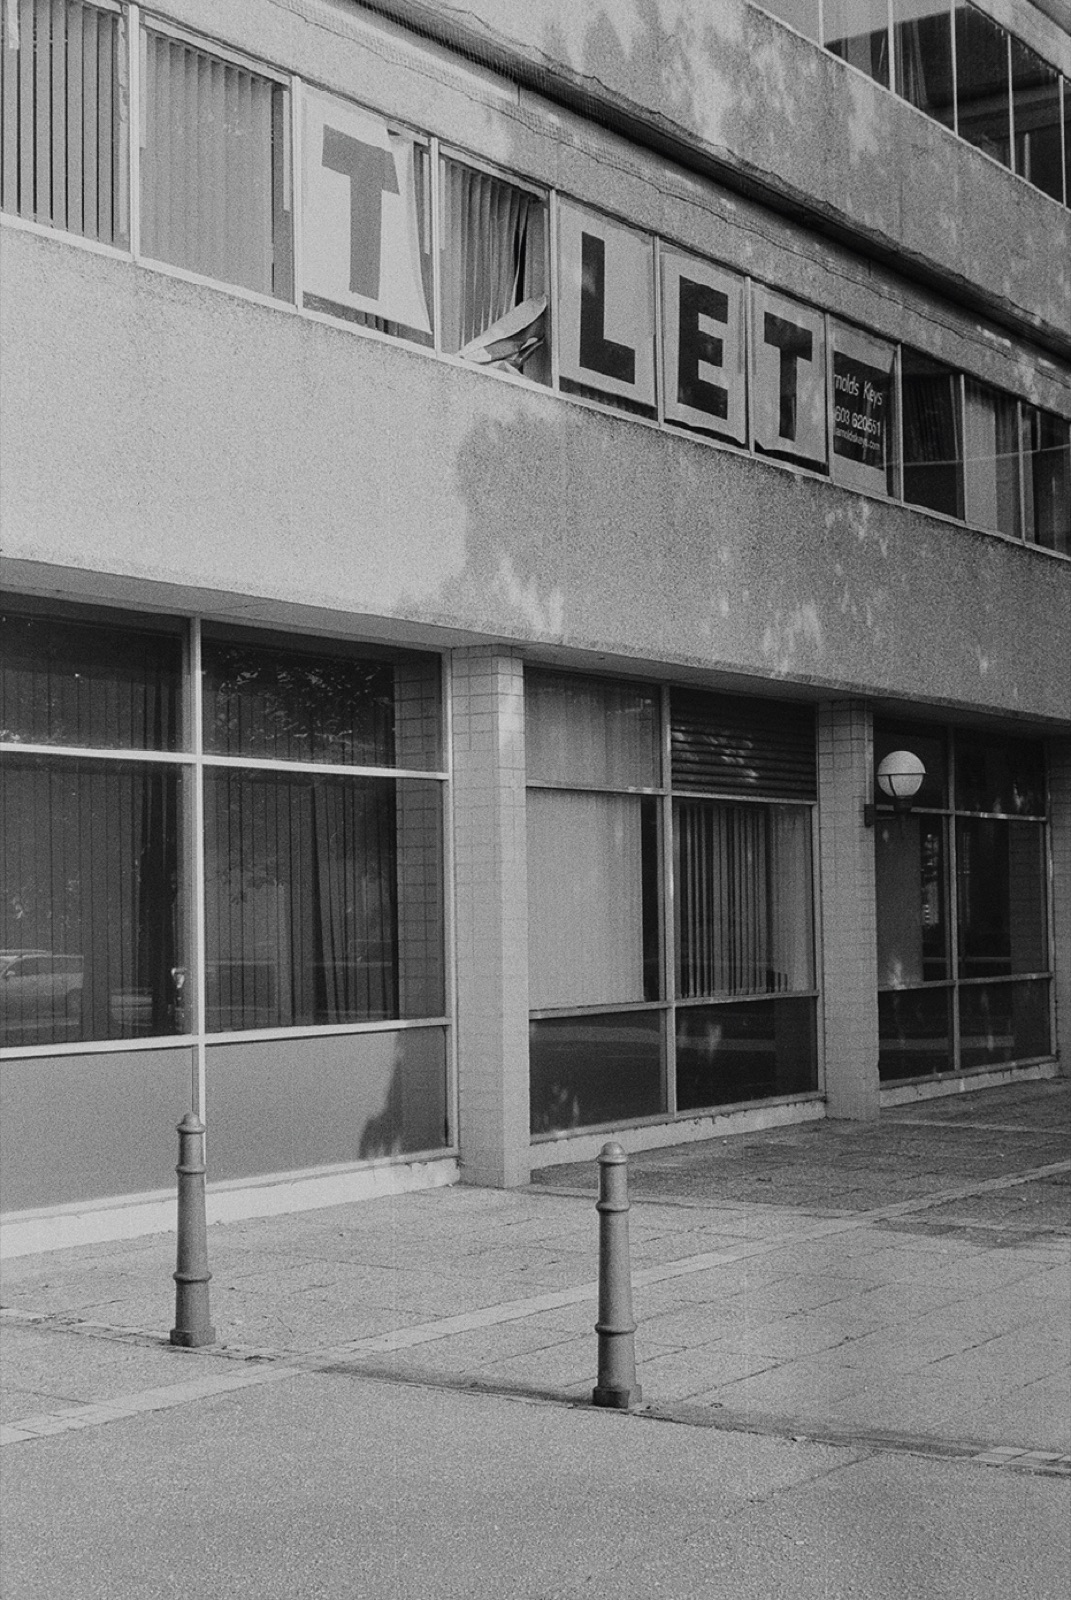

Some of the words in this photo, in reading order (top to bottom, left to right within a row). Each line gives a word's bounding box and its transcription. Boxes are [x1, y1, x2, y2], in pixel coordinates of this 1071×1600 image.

[579, 231, 812, 441] LET
[863, 380, 883, 409] Keys
[851, 412, 881, 437] 620551
